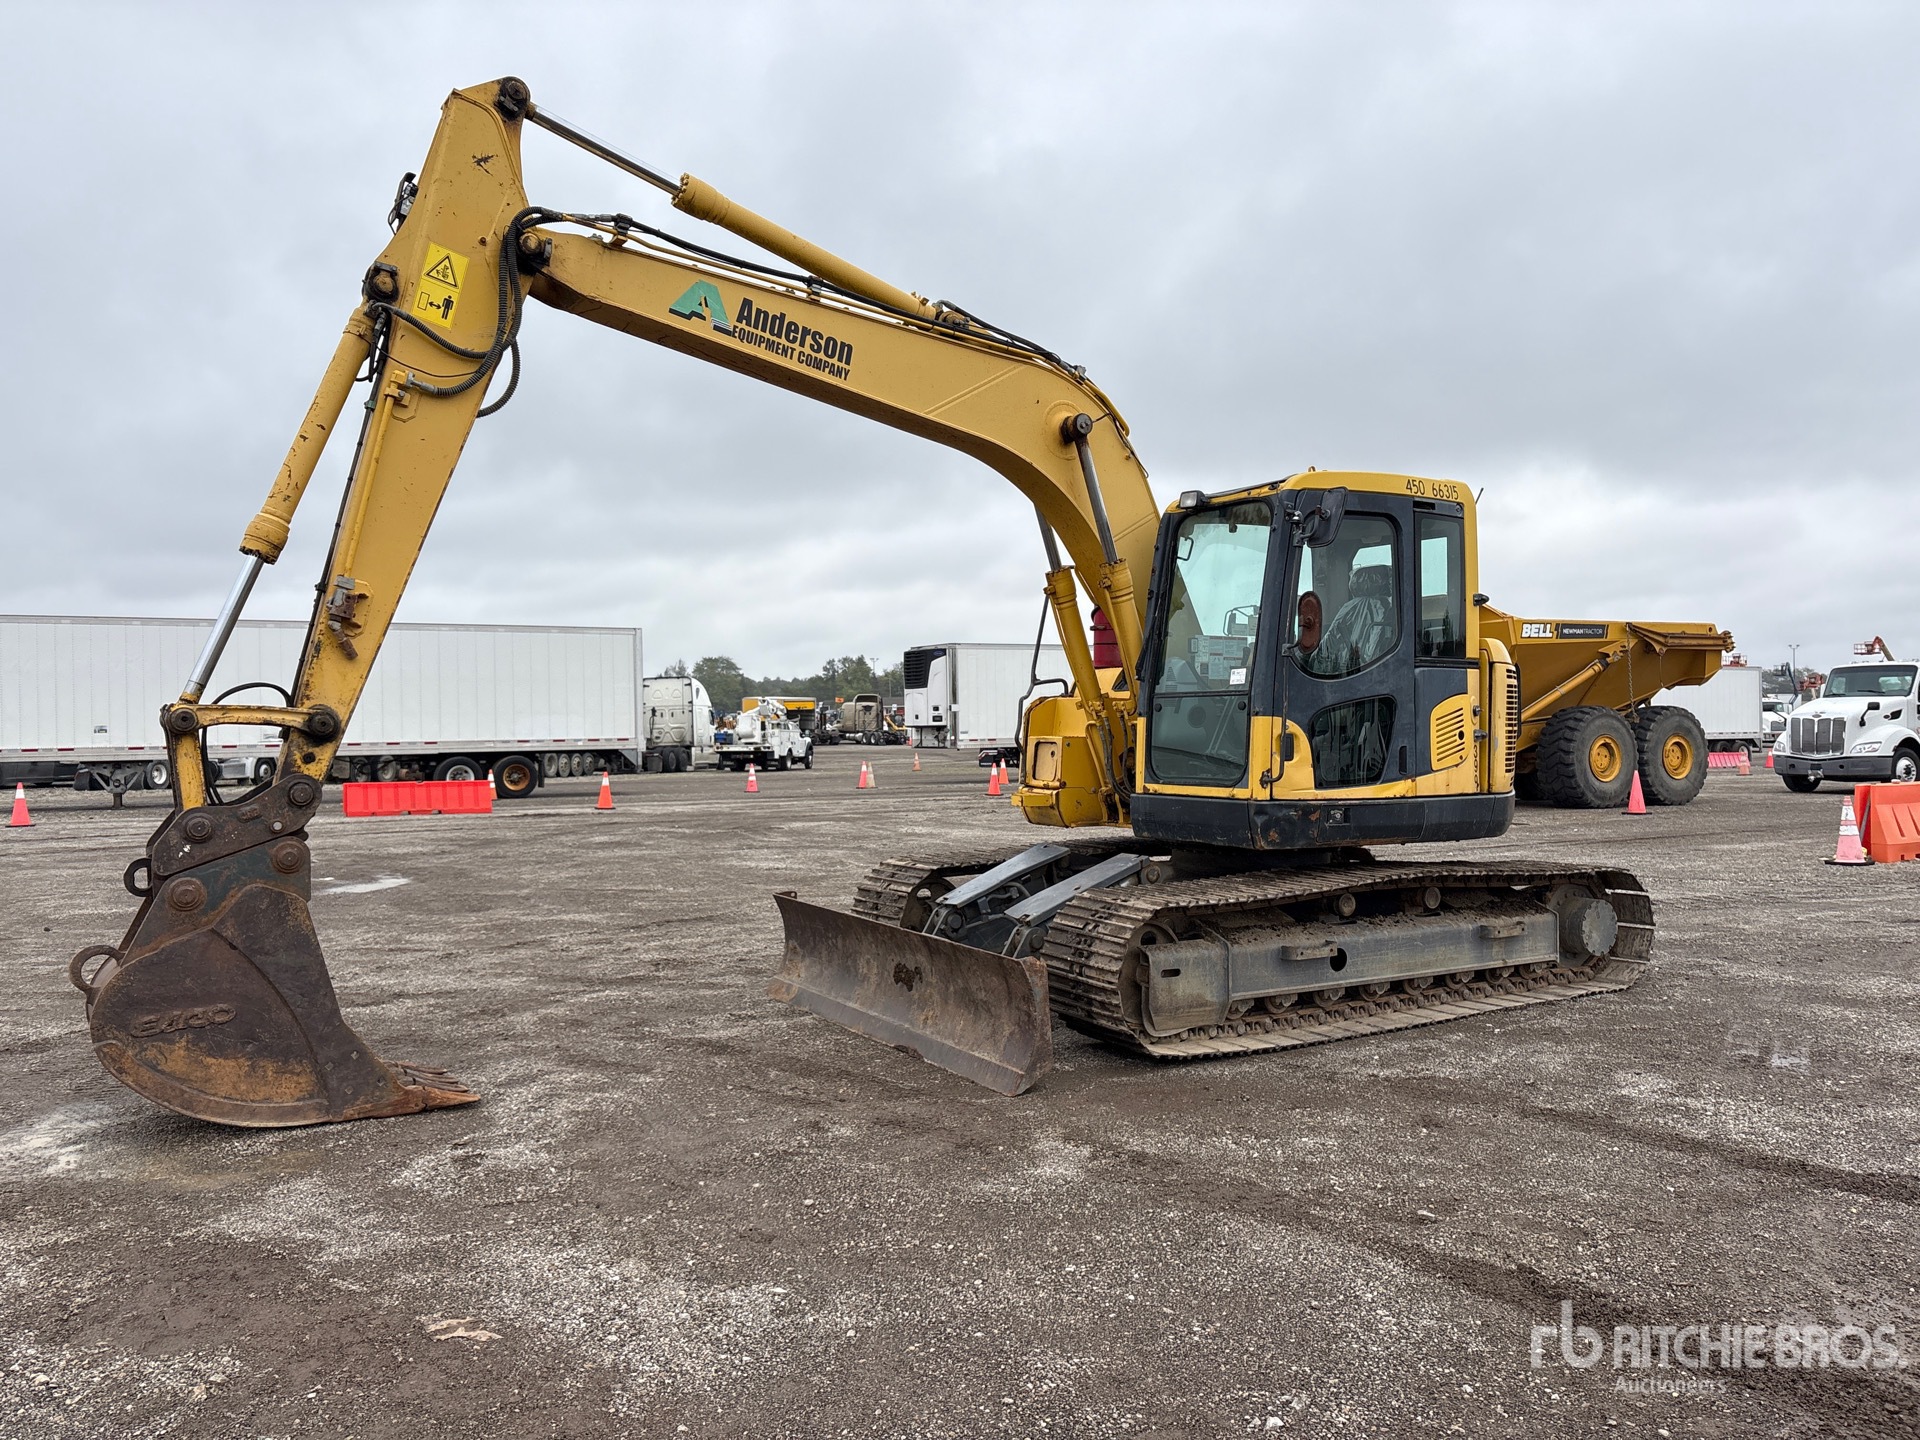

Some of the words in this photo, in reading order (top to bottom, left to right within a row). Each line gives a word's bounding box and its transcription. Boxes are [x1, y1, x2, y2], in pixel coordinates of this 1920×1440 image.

[736, 297, 854, 366] Anderson
[731, 325, 796, 360] EQUIPMENT
[797, 350, 850, 381] COMPANY
[1405, 479, 1426, 496] 450
[1432, 482, 1459, 500] 66315
[1521, 623, 1553, 638] BELL
